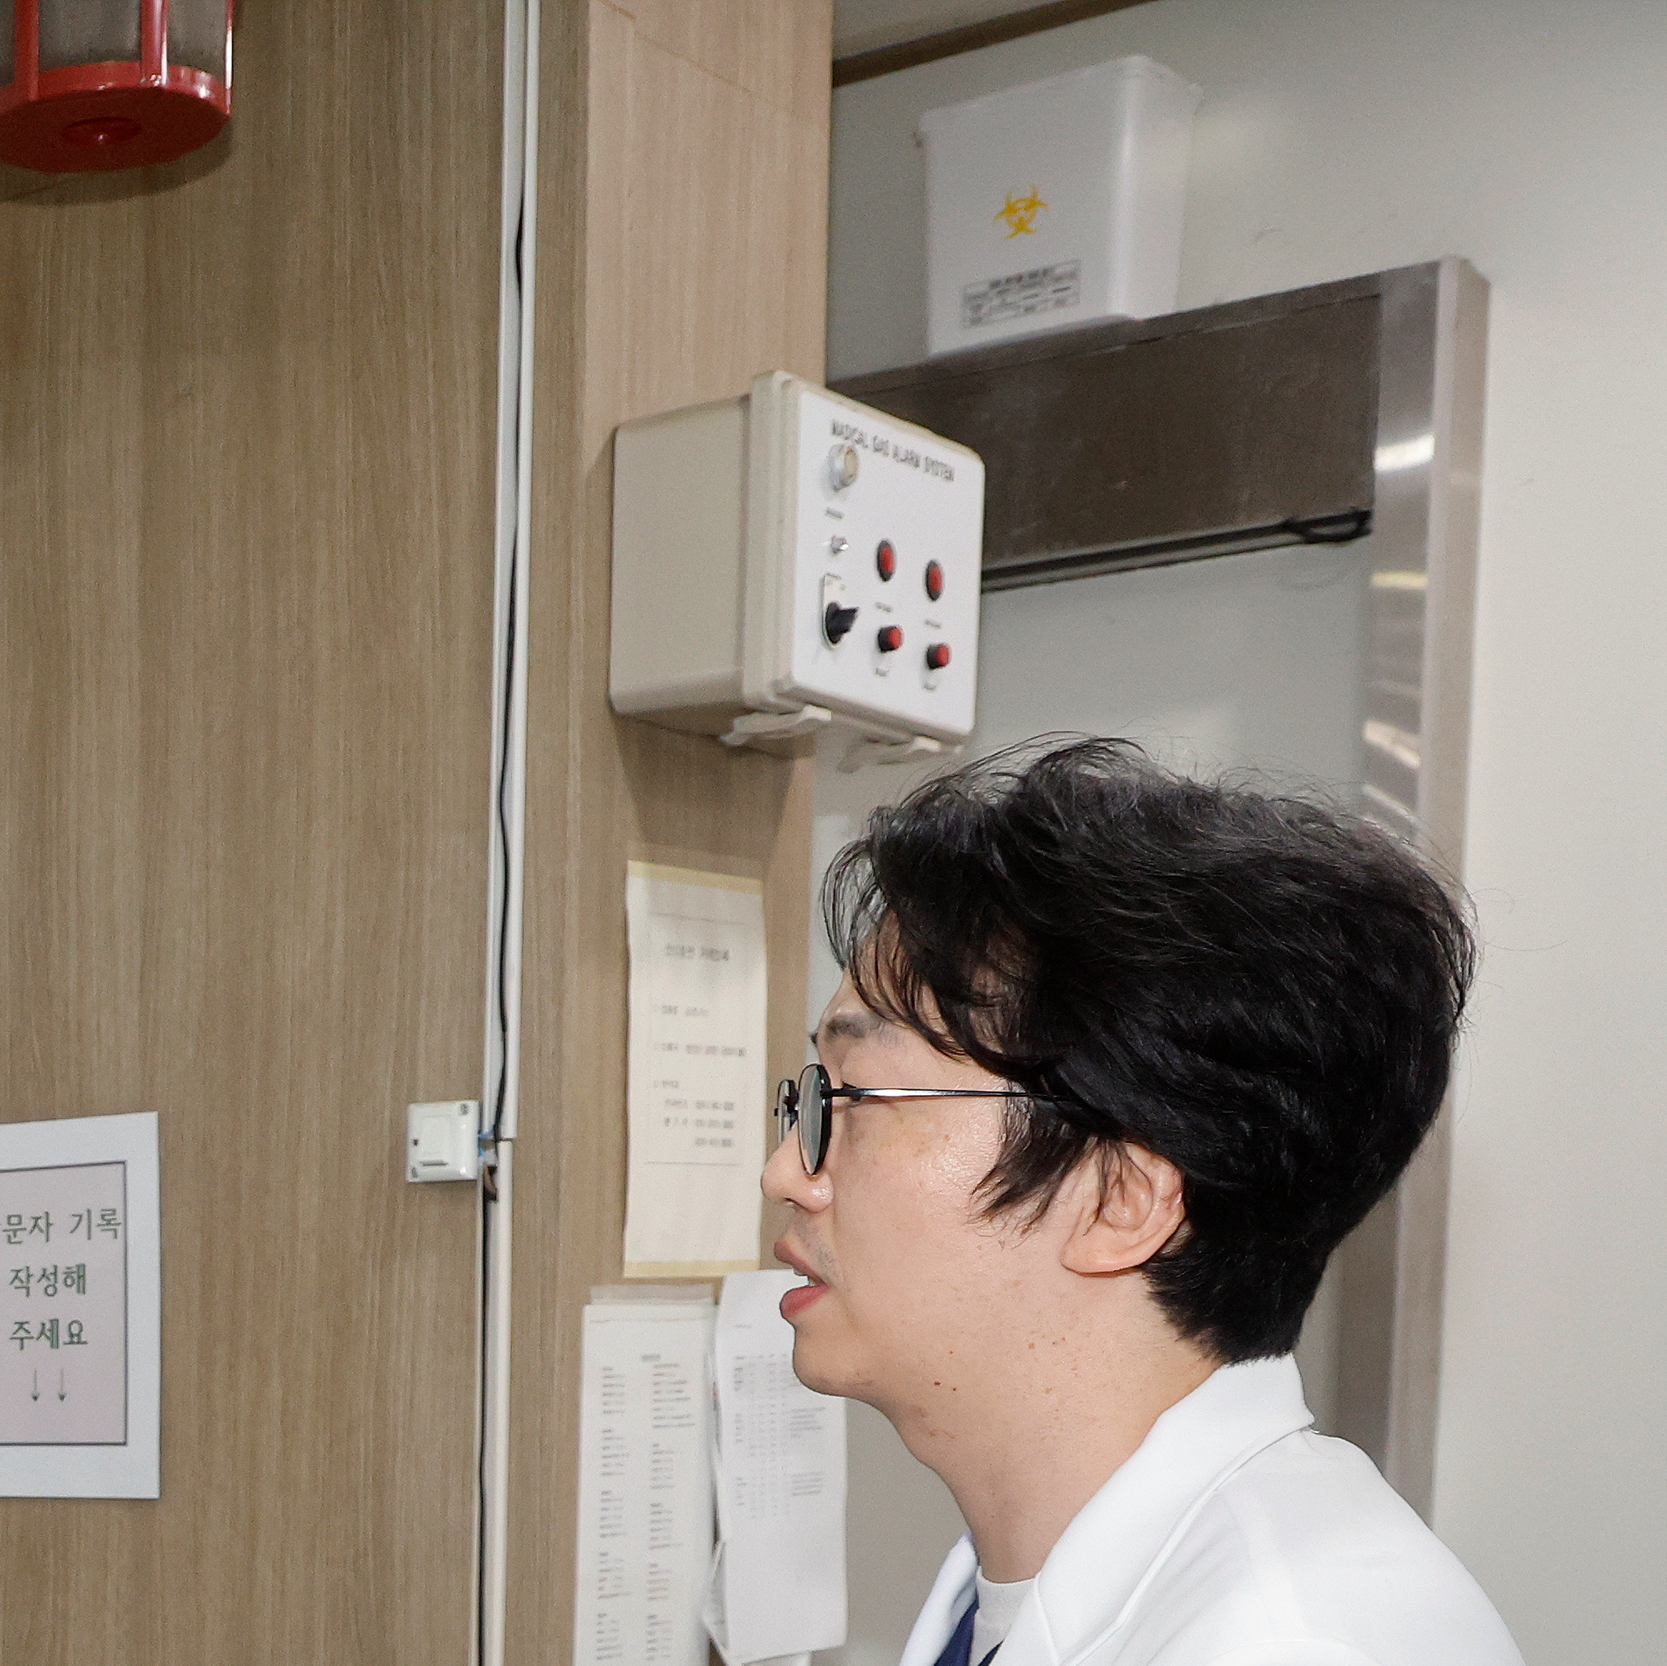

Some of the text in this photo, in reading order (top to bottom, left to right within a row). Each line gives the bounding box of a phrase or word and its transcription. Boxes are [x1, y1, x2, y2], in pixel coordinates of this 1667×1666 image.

[68, 1207, 123, 1243] 기록
[8, 1262, 88, 1299] 작성해
[8, 1318, 89, 1352] 주세요
